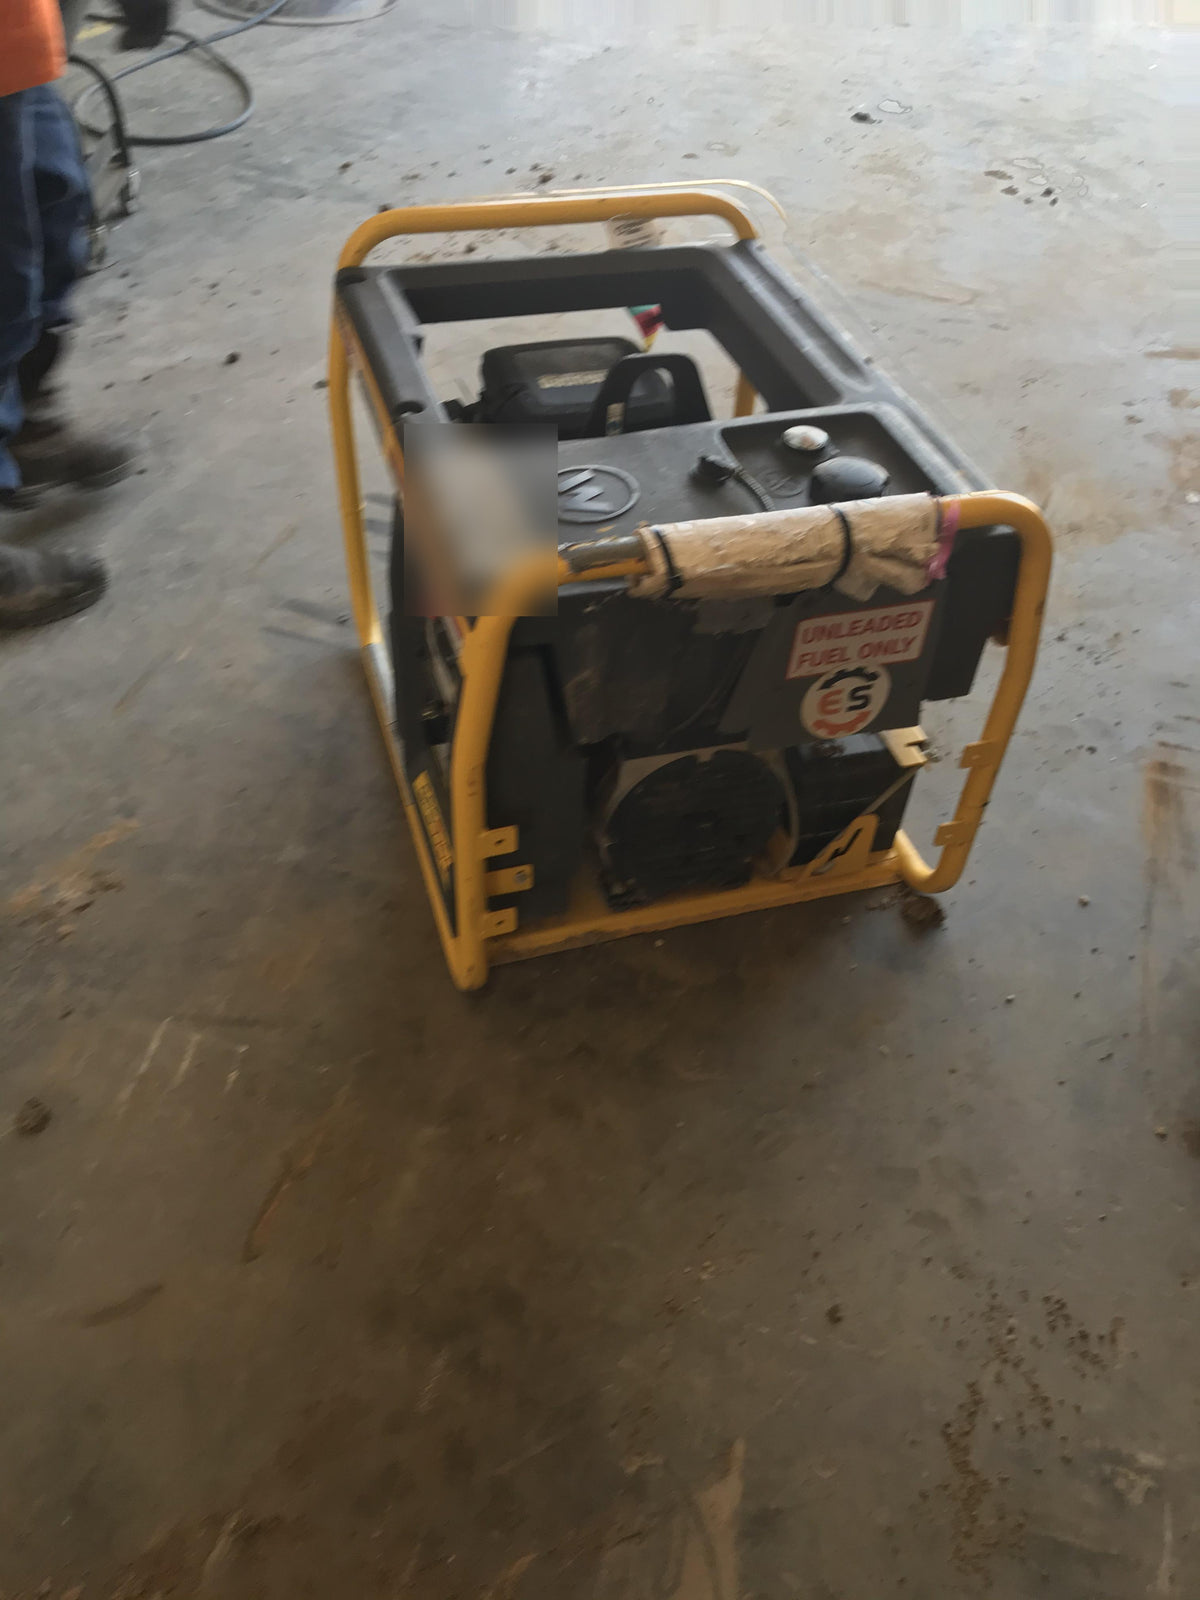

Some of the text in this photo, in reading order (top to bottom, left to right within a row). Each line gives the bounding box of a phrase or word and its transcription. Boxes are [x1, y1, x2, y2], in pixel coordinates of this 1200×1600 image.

[802, 611, 924, 645] UNLEADED
[799, 636, 918, 668] FUEL ONLY
